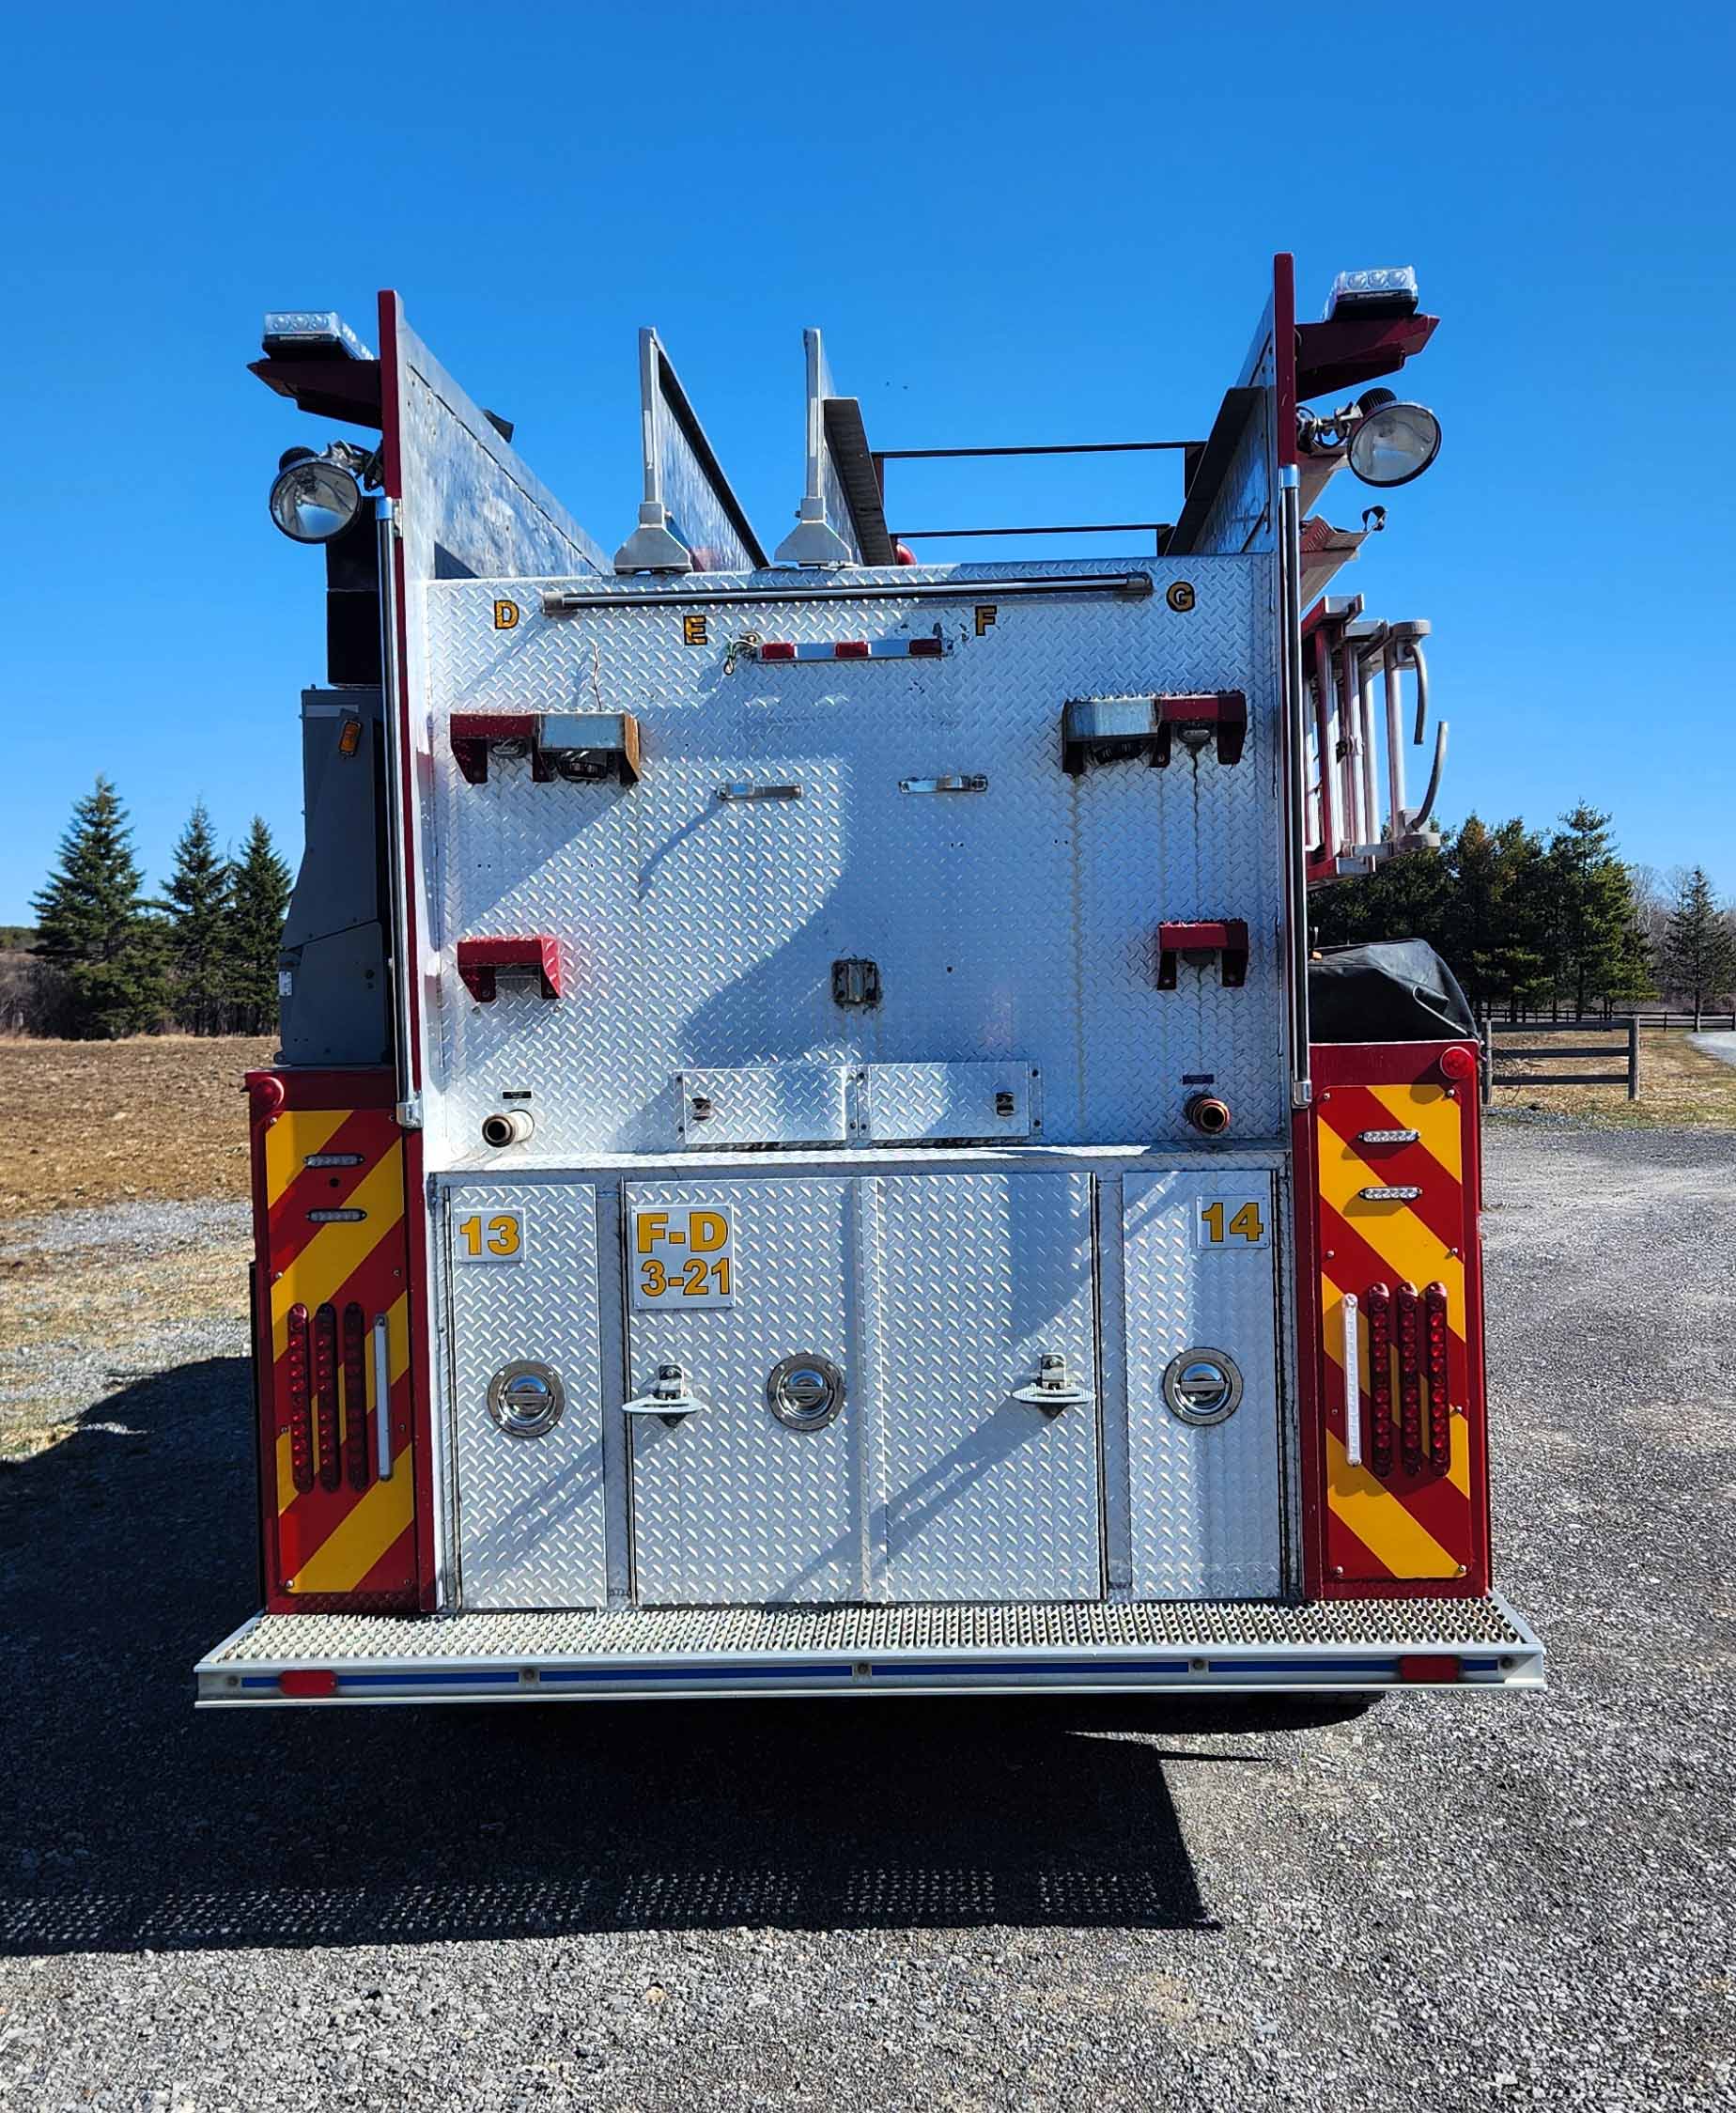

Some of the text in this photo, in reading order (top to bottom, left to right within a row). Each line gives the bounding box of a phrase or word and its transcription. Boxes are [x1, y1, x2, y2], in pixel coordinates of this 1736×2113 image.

[495, 599, 519, 630] D
[1166, 582, 1195, 612] G
[684, 615, 707, 645] E
[975, 606, 998, 636] F
[460, 1215, 520, 1256] 13
[636, 1212, 728, 1253] F-D
[1201, 1202, 1264, 1242] 14
[641, 1257, 730, 1297] 3-21
